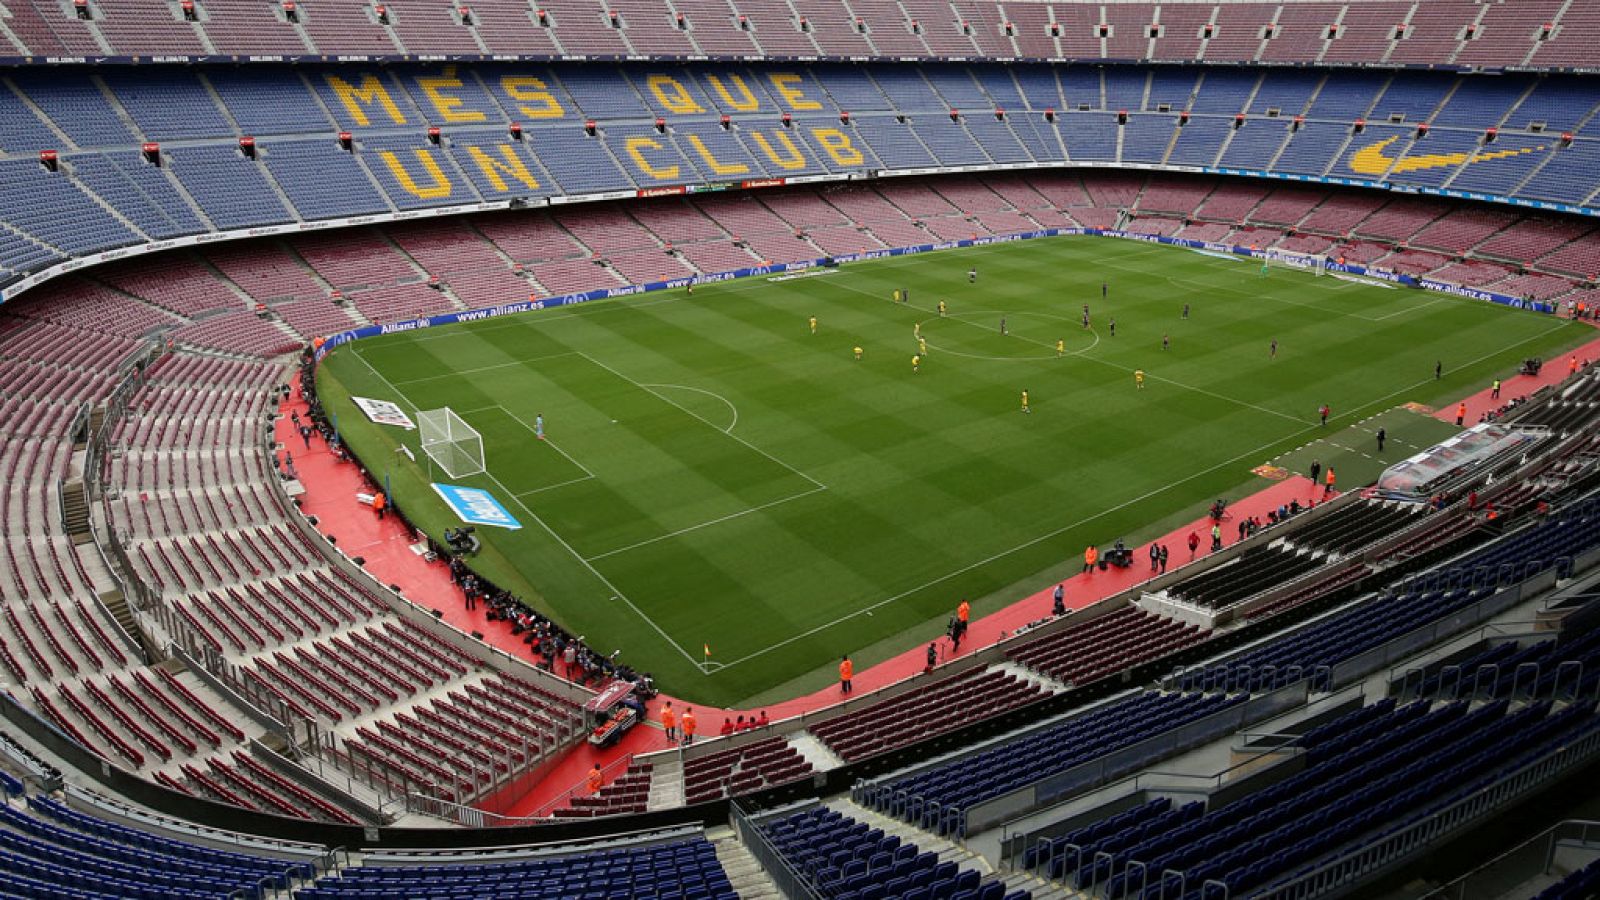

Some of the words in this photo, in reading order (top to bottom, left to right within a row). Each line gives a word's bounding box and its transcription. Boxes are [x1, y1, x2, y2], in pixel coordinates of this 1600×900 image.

[325, 65, 565, 126] MÉS
[646, 74, 822, 114] QUE
[376, 144, 540, 199] UN
[624, 128, 864, 179] CLUB
[1419, 281, 1492, 301] www.allianz.es
[456, 300, 545, 323] www.allianz.es
[380, 320, 417, 334] Allianz
